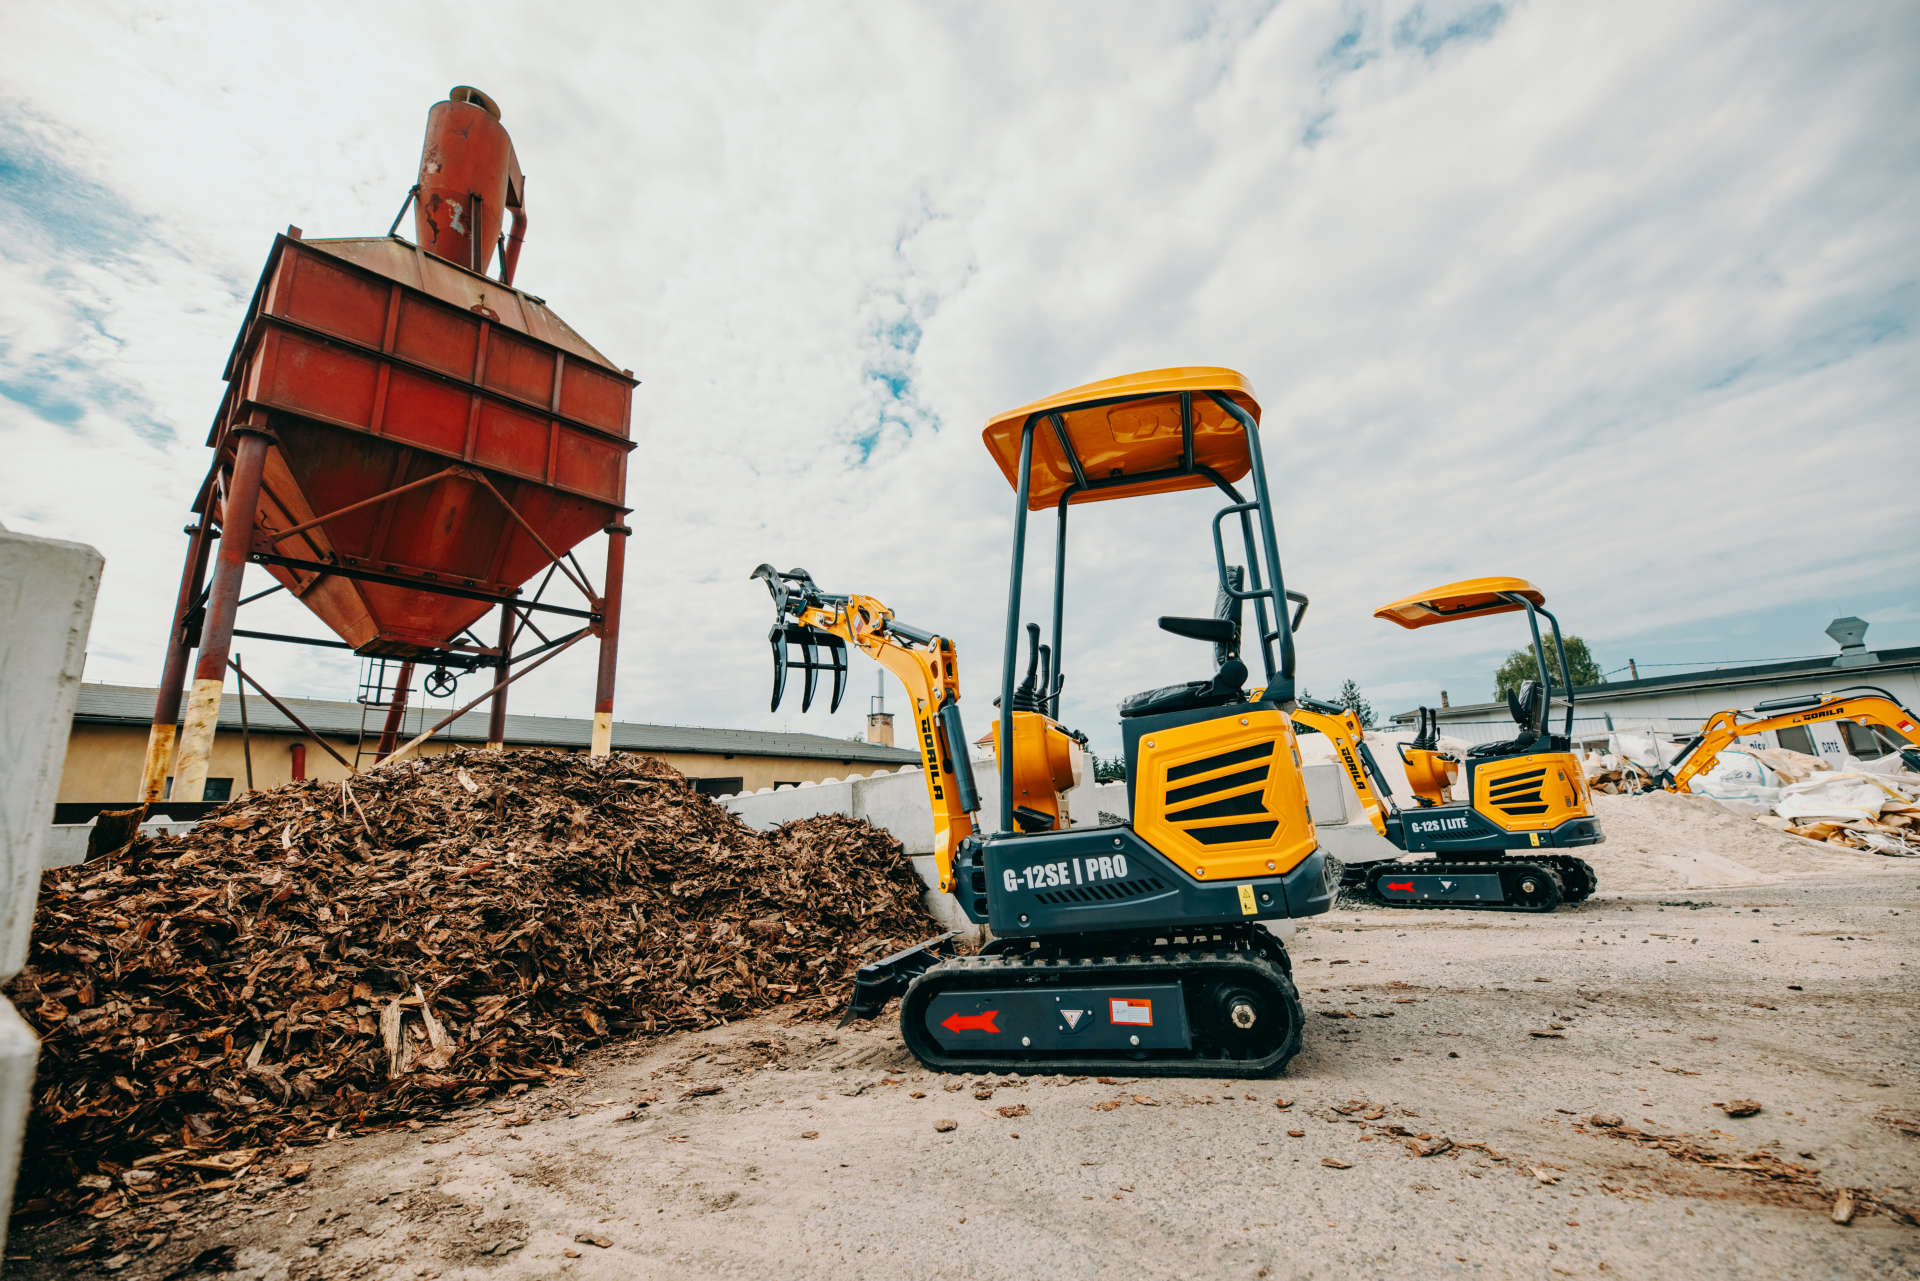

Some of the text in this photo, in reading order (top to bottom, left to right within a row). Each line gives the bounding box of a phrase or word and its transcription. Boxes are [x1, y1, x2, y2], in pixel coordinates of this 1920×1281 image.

[1803, 707, 1844, 721] GORILA
[922, 715, 944, 800] GORILA
[1341, 747, 1366, 790] GORILA
[1411, 820, 1440, 833] G-12S
[1446, 817, 1469, 830] LITE
[1003, 862, 1071, 892] G-12SE
[1085, 854, 1128, 881] PRO
